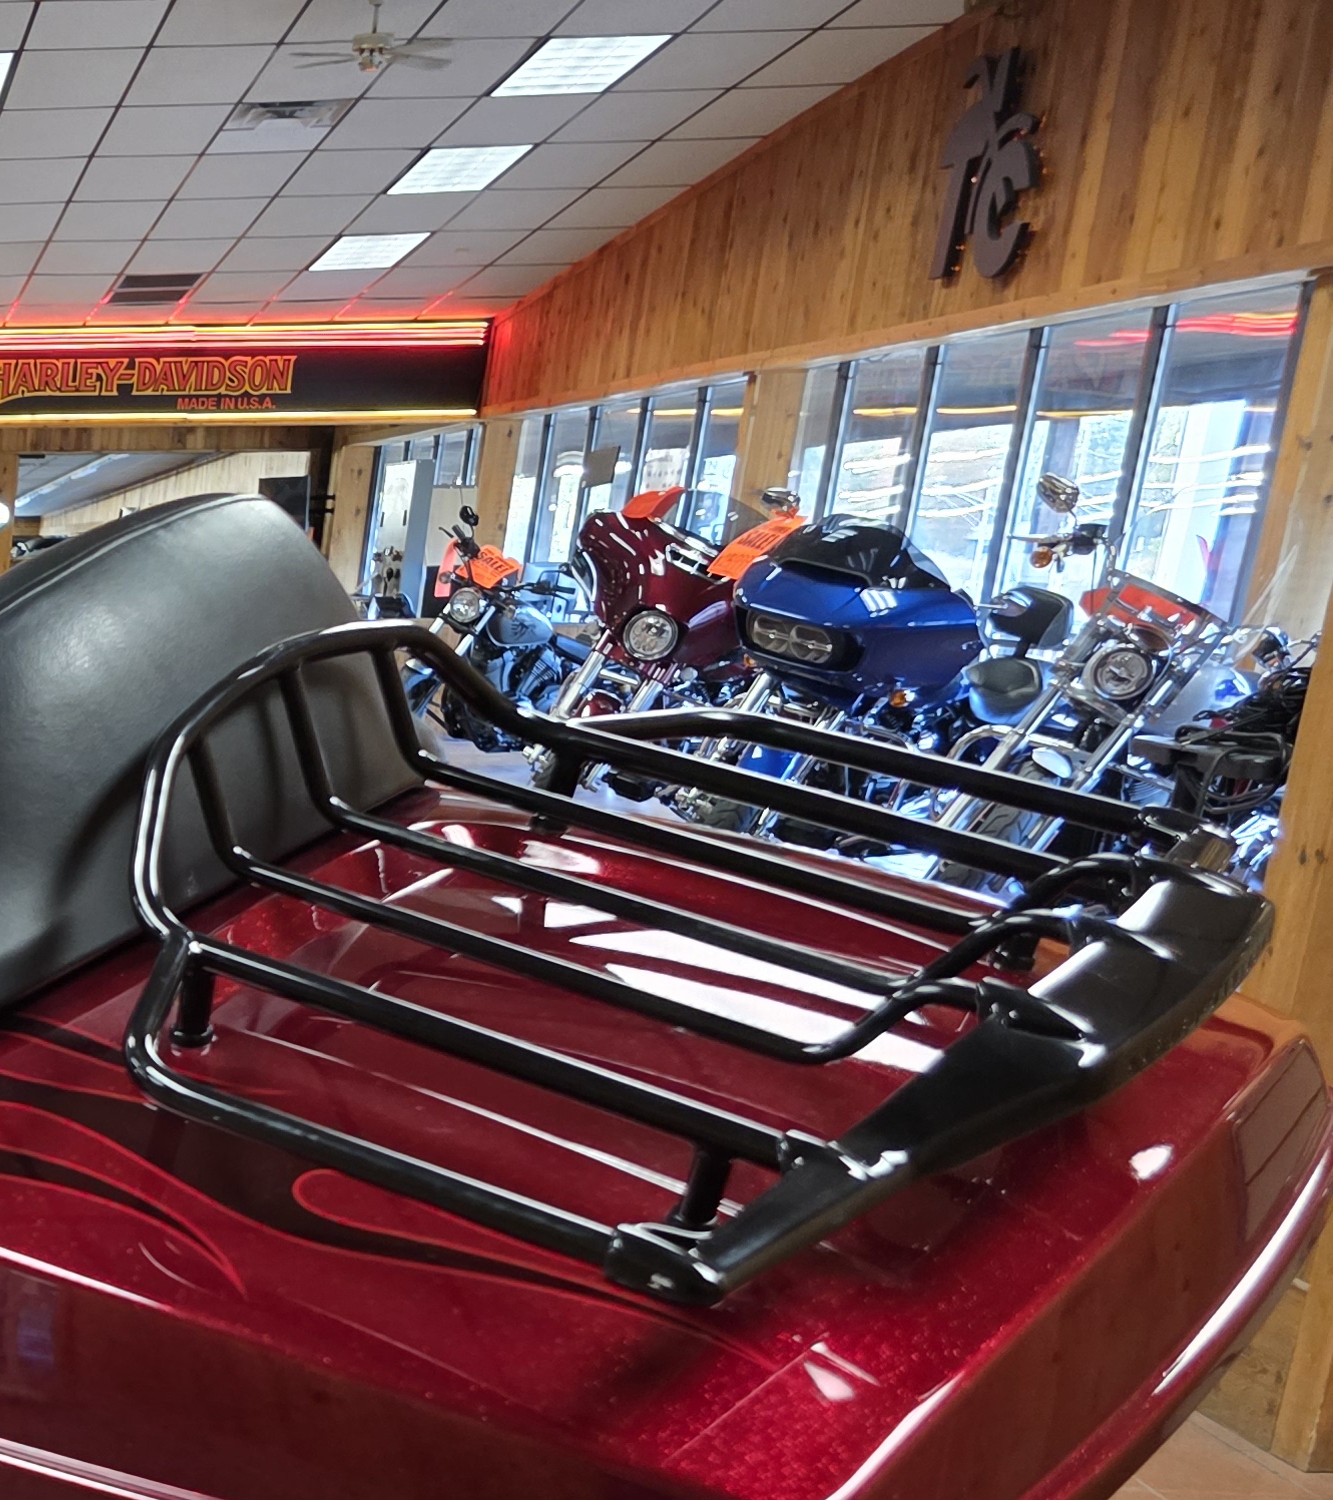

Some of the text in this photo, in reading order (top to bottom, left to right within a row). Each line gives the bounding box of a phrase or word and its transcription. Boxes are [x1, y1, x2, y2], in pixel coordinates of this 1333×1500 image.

[177, 396, 276, 409] MADE IN U.S.A.
[480, 551, 510, 573] SALE!
